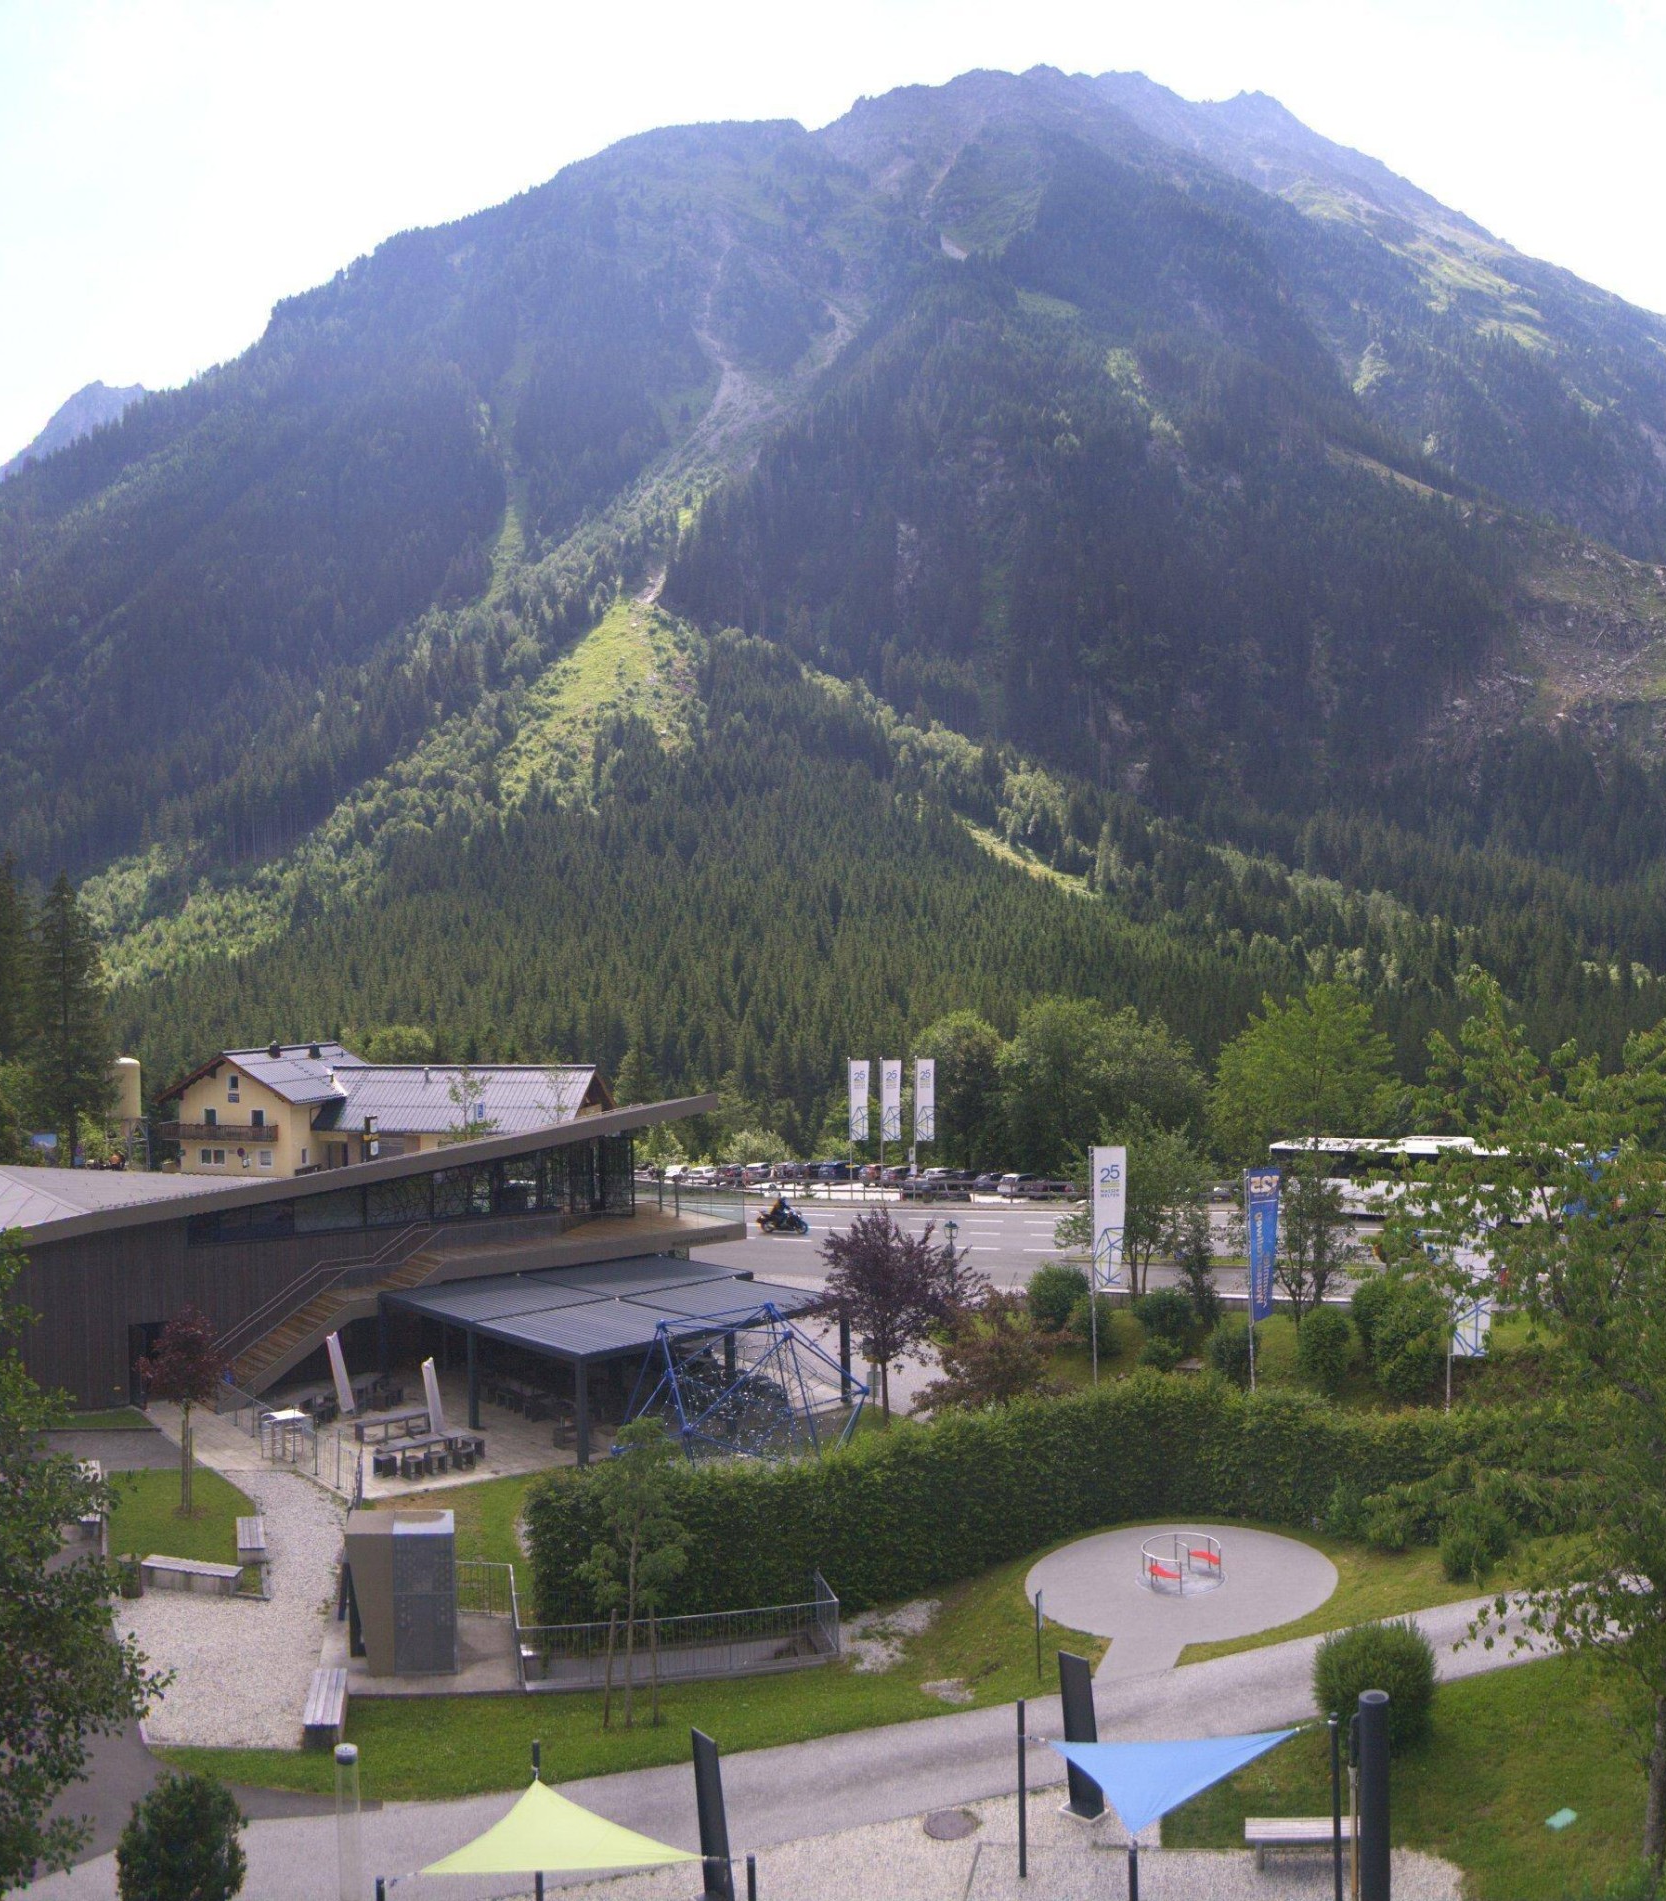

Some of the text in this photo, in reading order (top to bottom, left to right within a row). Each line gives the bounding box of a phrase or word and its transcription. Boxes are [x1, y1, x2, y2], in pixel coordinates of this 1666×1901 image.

[854, 1070, 866, 1082] 25
[886, 1069, 898, 1081] 25
[920, 1069, 931, 1080] 25
[1100, 1164, 1120, 1184] 25
